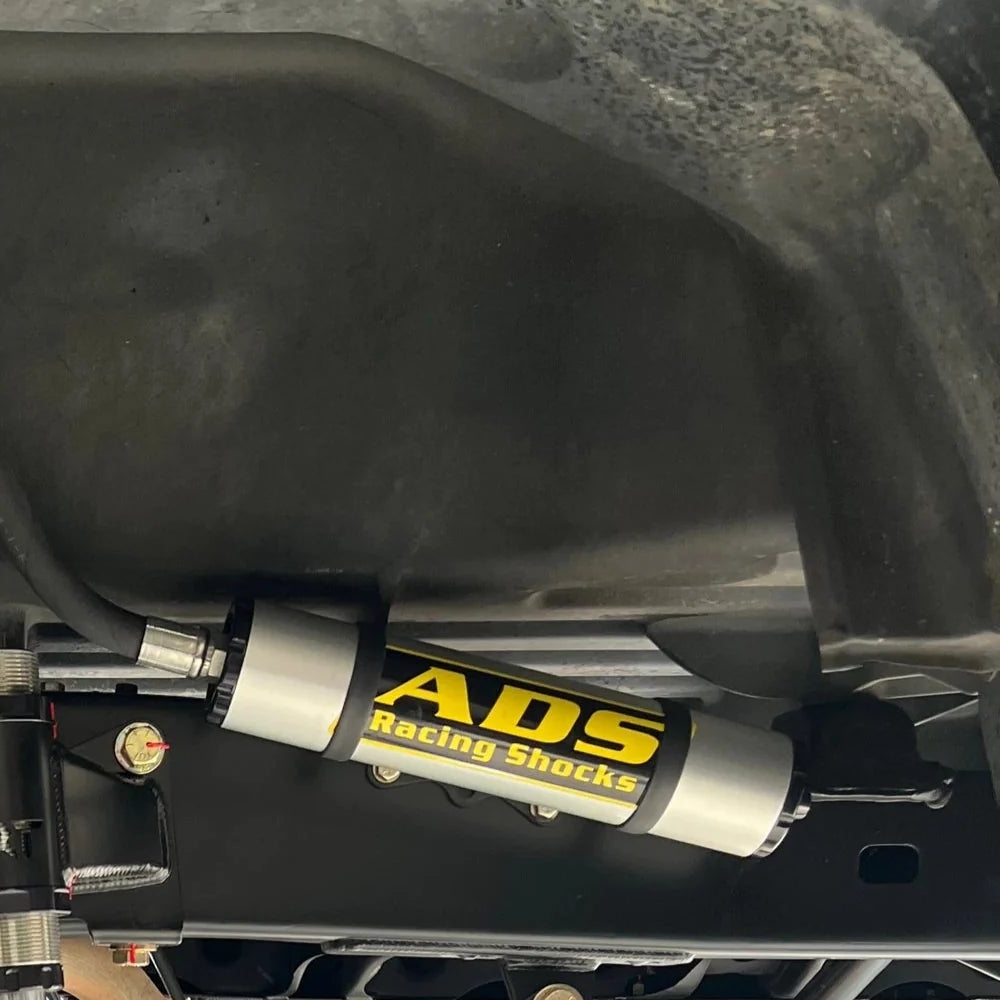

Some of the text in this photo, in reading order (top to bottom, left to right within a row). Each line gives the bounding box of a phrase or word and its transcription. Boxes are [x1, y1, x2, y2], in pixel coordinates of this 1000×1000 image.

[368, 709, 638, 793] Racing Shocks
[374, 666, 665, 765] ADS
